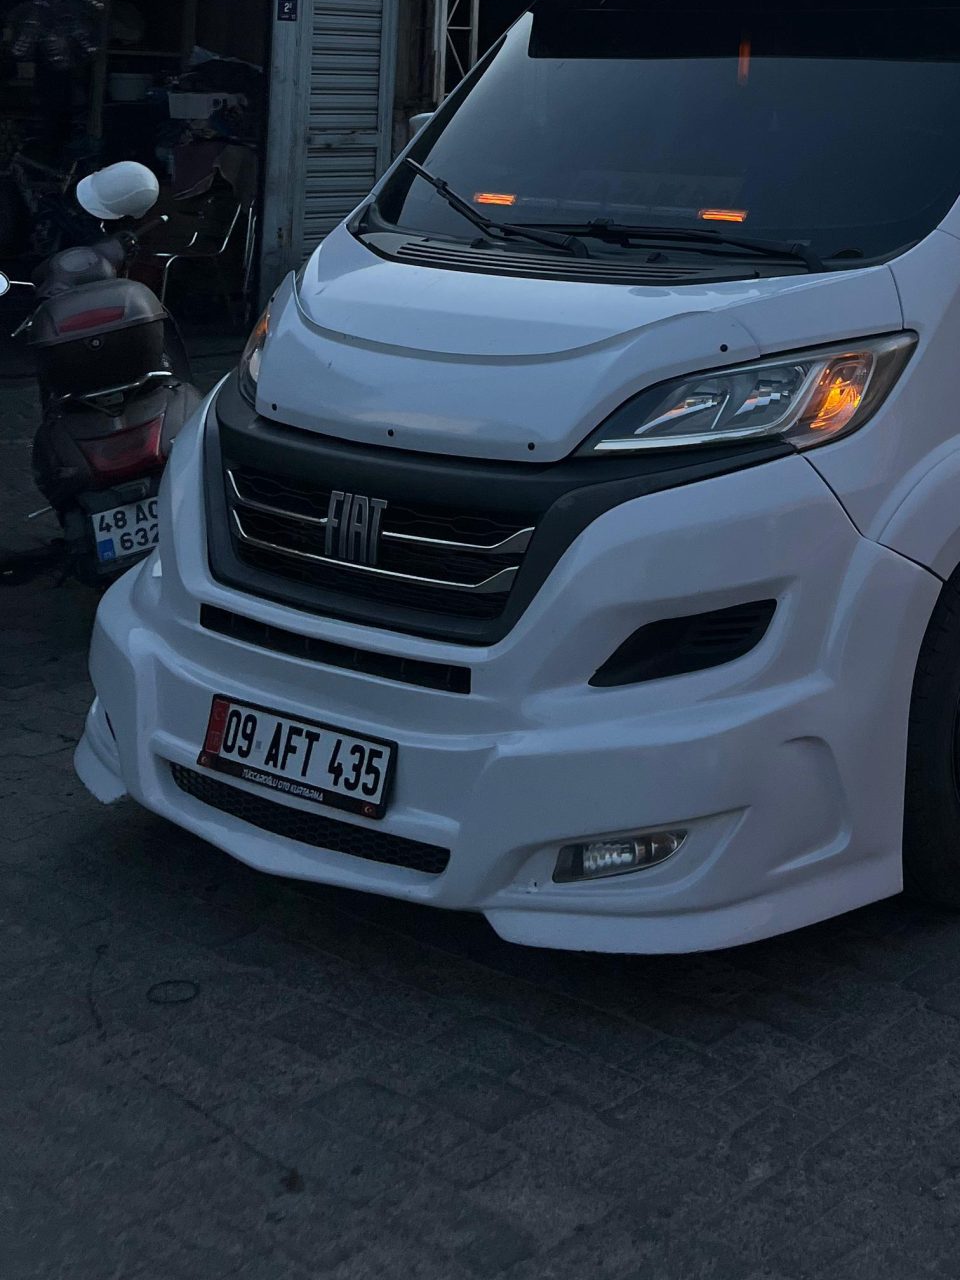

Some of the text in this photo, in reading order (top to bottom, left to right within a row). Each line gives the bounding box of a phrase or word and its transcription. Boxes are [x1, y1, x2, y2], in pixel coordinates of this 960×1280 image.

[99, 511, 127, 532] 48
[324, 490, 388, 565] FIAT
[222, 709, 384, 797] 09 AFT 435
